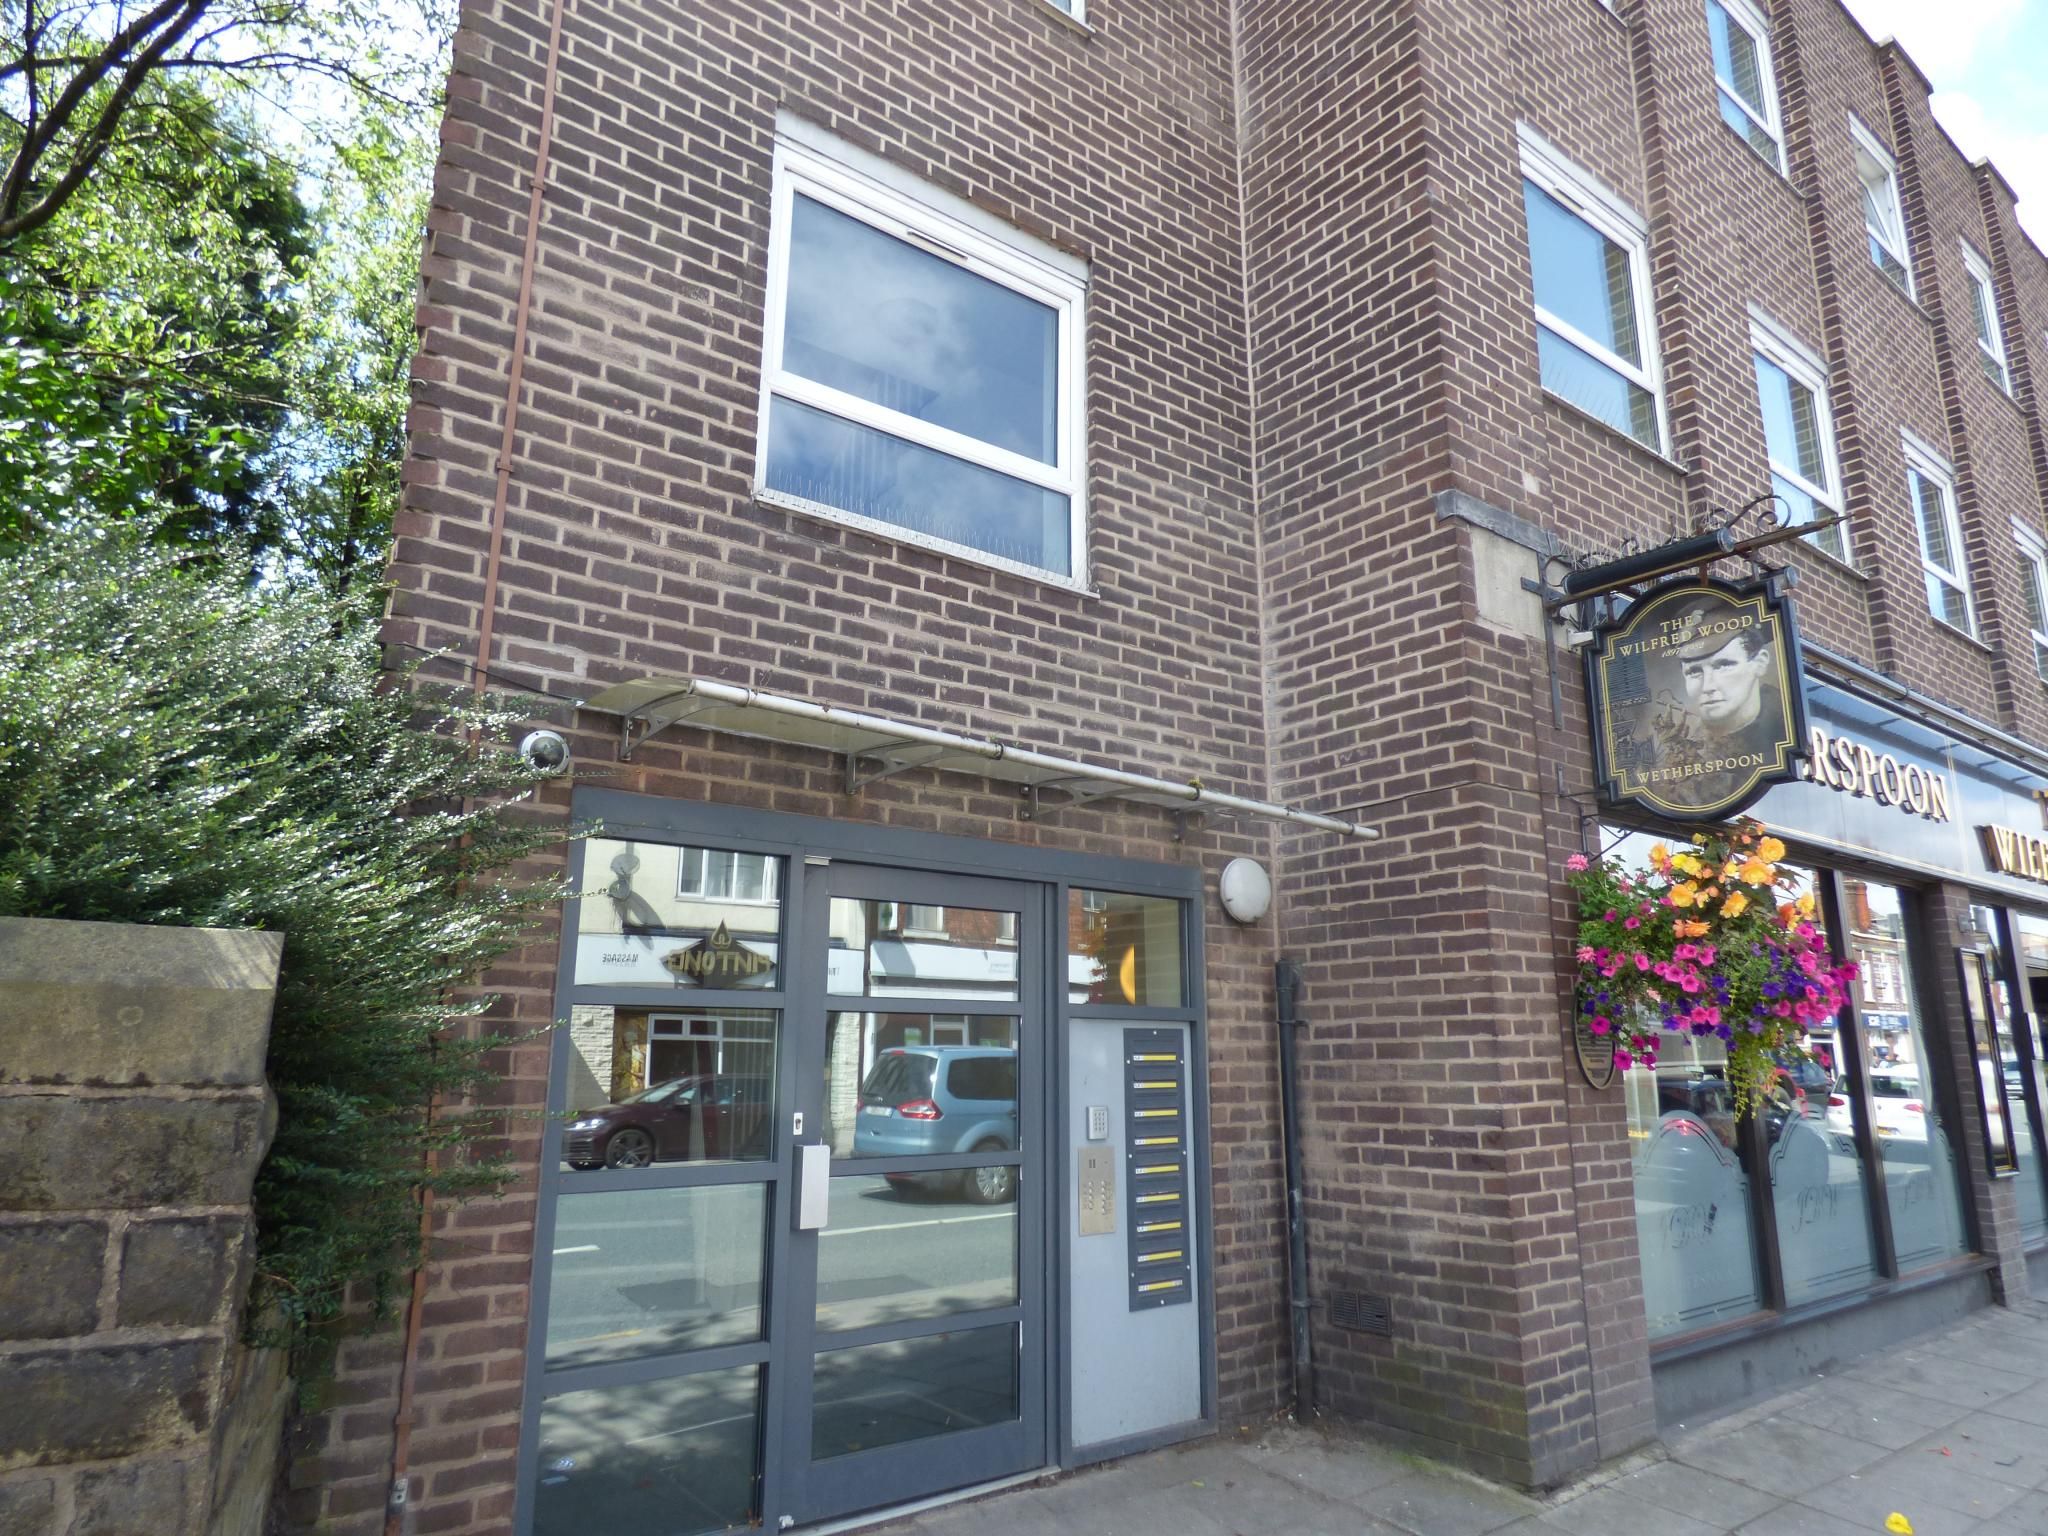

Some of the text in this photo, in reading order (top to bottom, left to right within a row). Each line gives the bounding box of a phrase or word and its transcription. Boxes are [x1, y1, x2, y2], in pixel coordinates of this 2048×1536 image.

[1619, 615, 1753, 657] WILFRED WOOD
[1659, 615, 1695, 632] THE
[1637, 753, 1764, 784] WETHERSPOON
[1803, 726, 1951, 822] RSPOON
